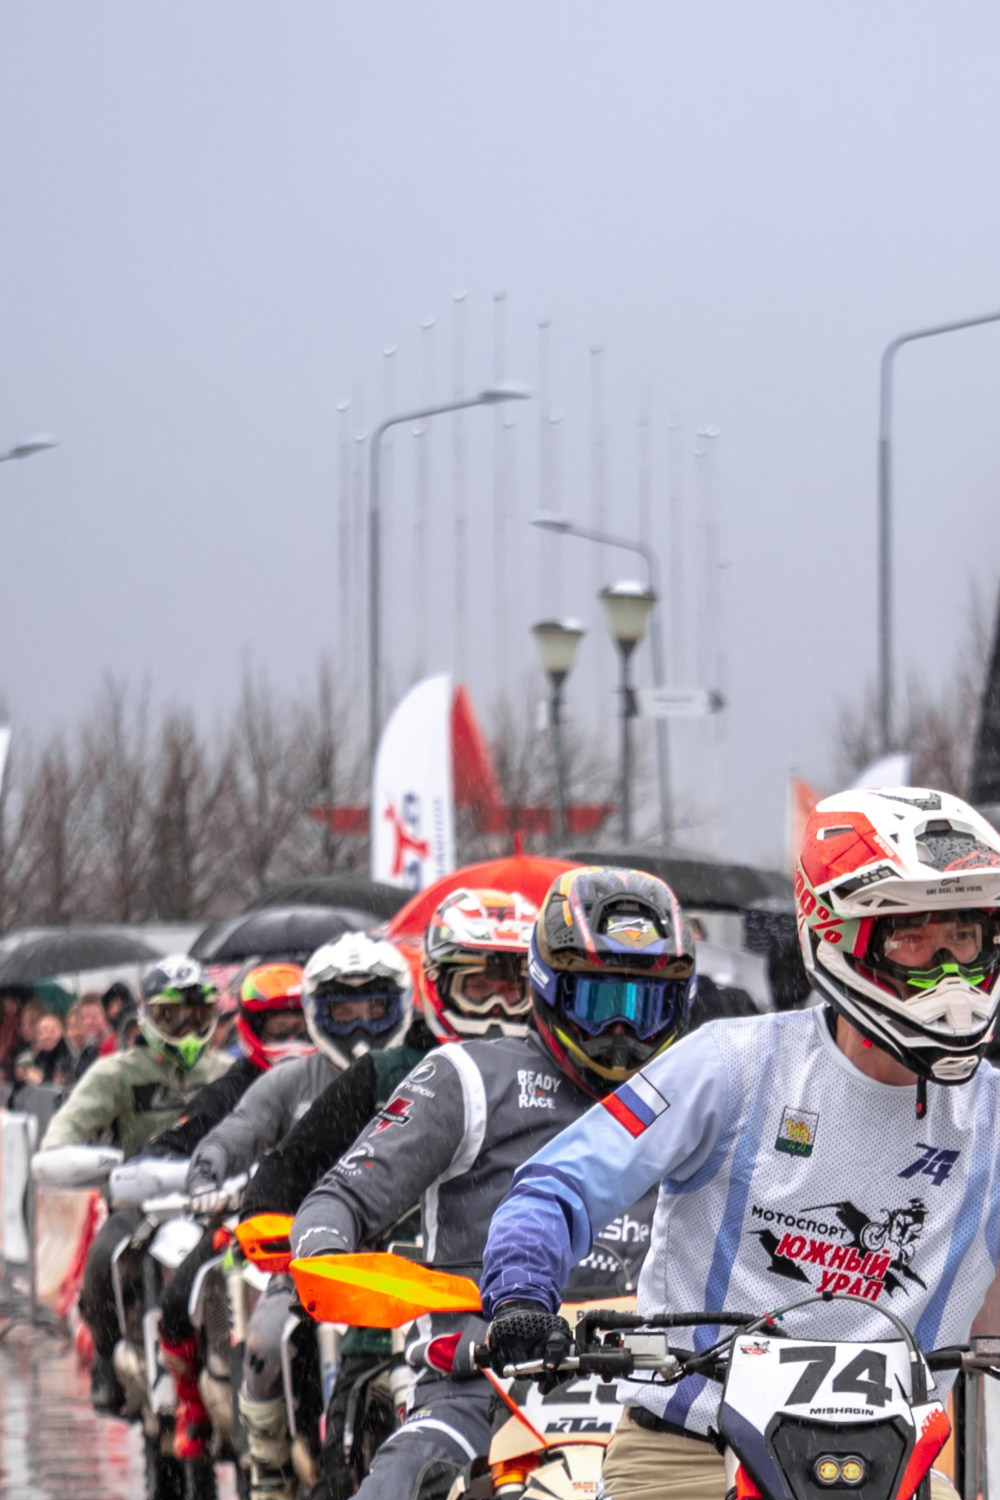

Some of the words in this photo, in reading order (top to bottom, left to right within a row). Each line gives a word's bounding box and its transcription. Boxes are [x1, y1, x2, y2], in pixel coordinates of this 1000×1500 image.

[517, 1069, 561, 1093] READY
[520, 1083, 536, 1096] TO
[518, 1094, 556, 1109] RACE
[897, 1142, 961, 1187] 74
[751, 1204, 847, 1239] МОТОСПОРТ
[775, 1233, 892, 1279] ЮЖНЫЙ
[815, 1269, 886, 1302] УРАЛ
[779, 1345, 893, 1408] 74
[544, 1417, 612, 1433] KTM
[809, 1407, 875, 1416] MISHAGIN
